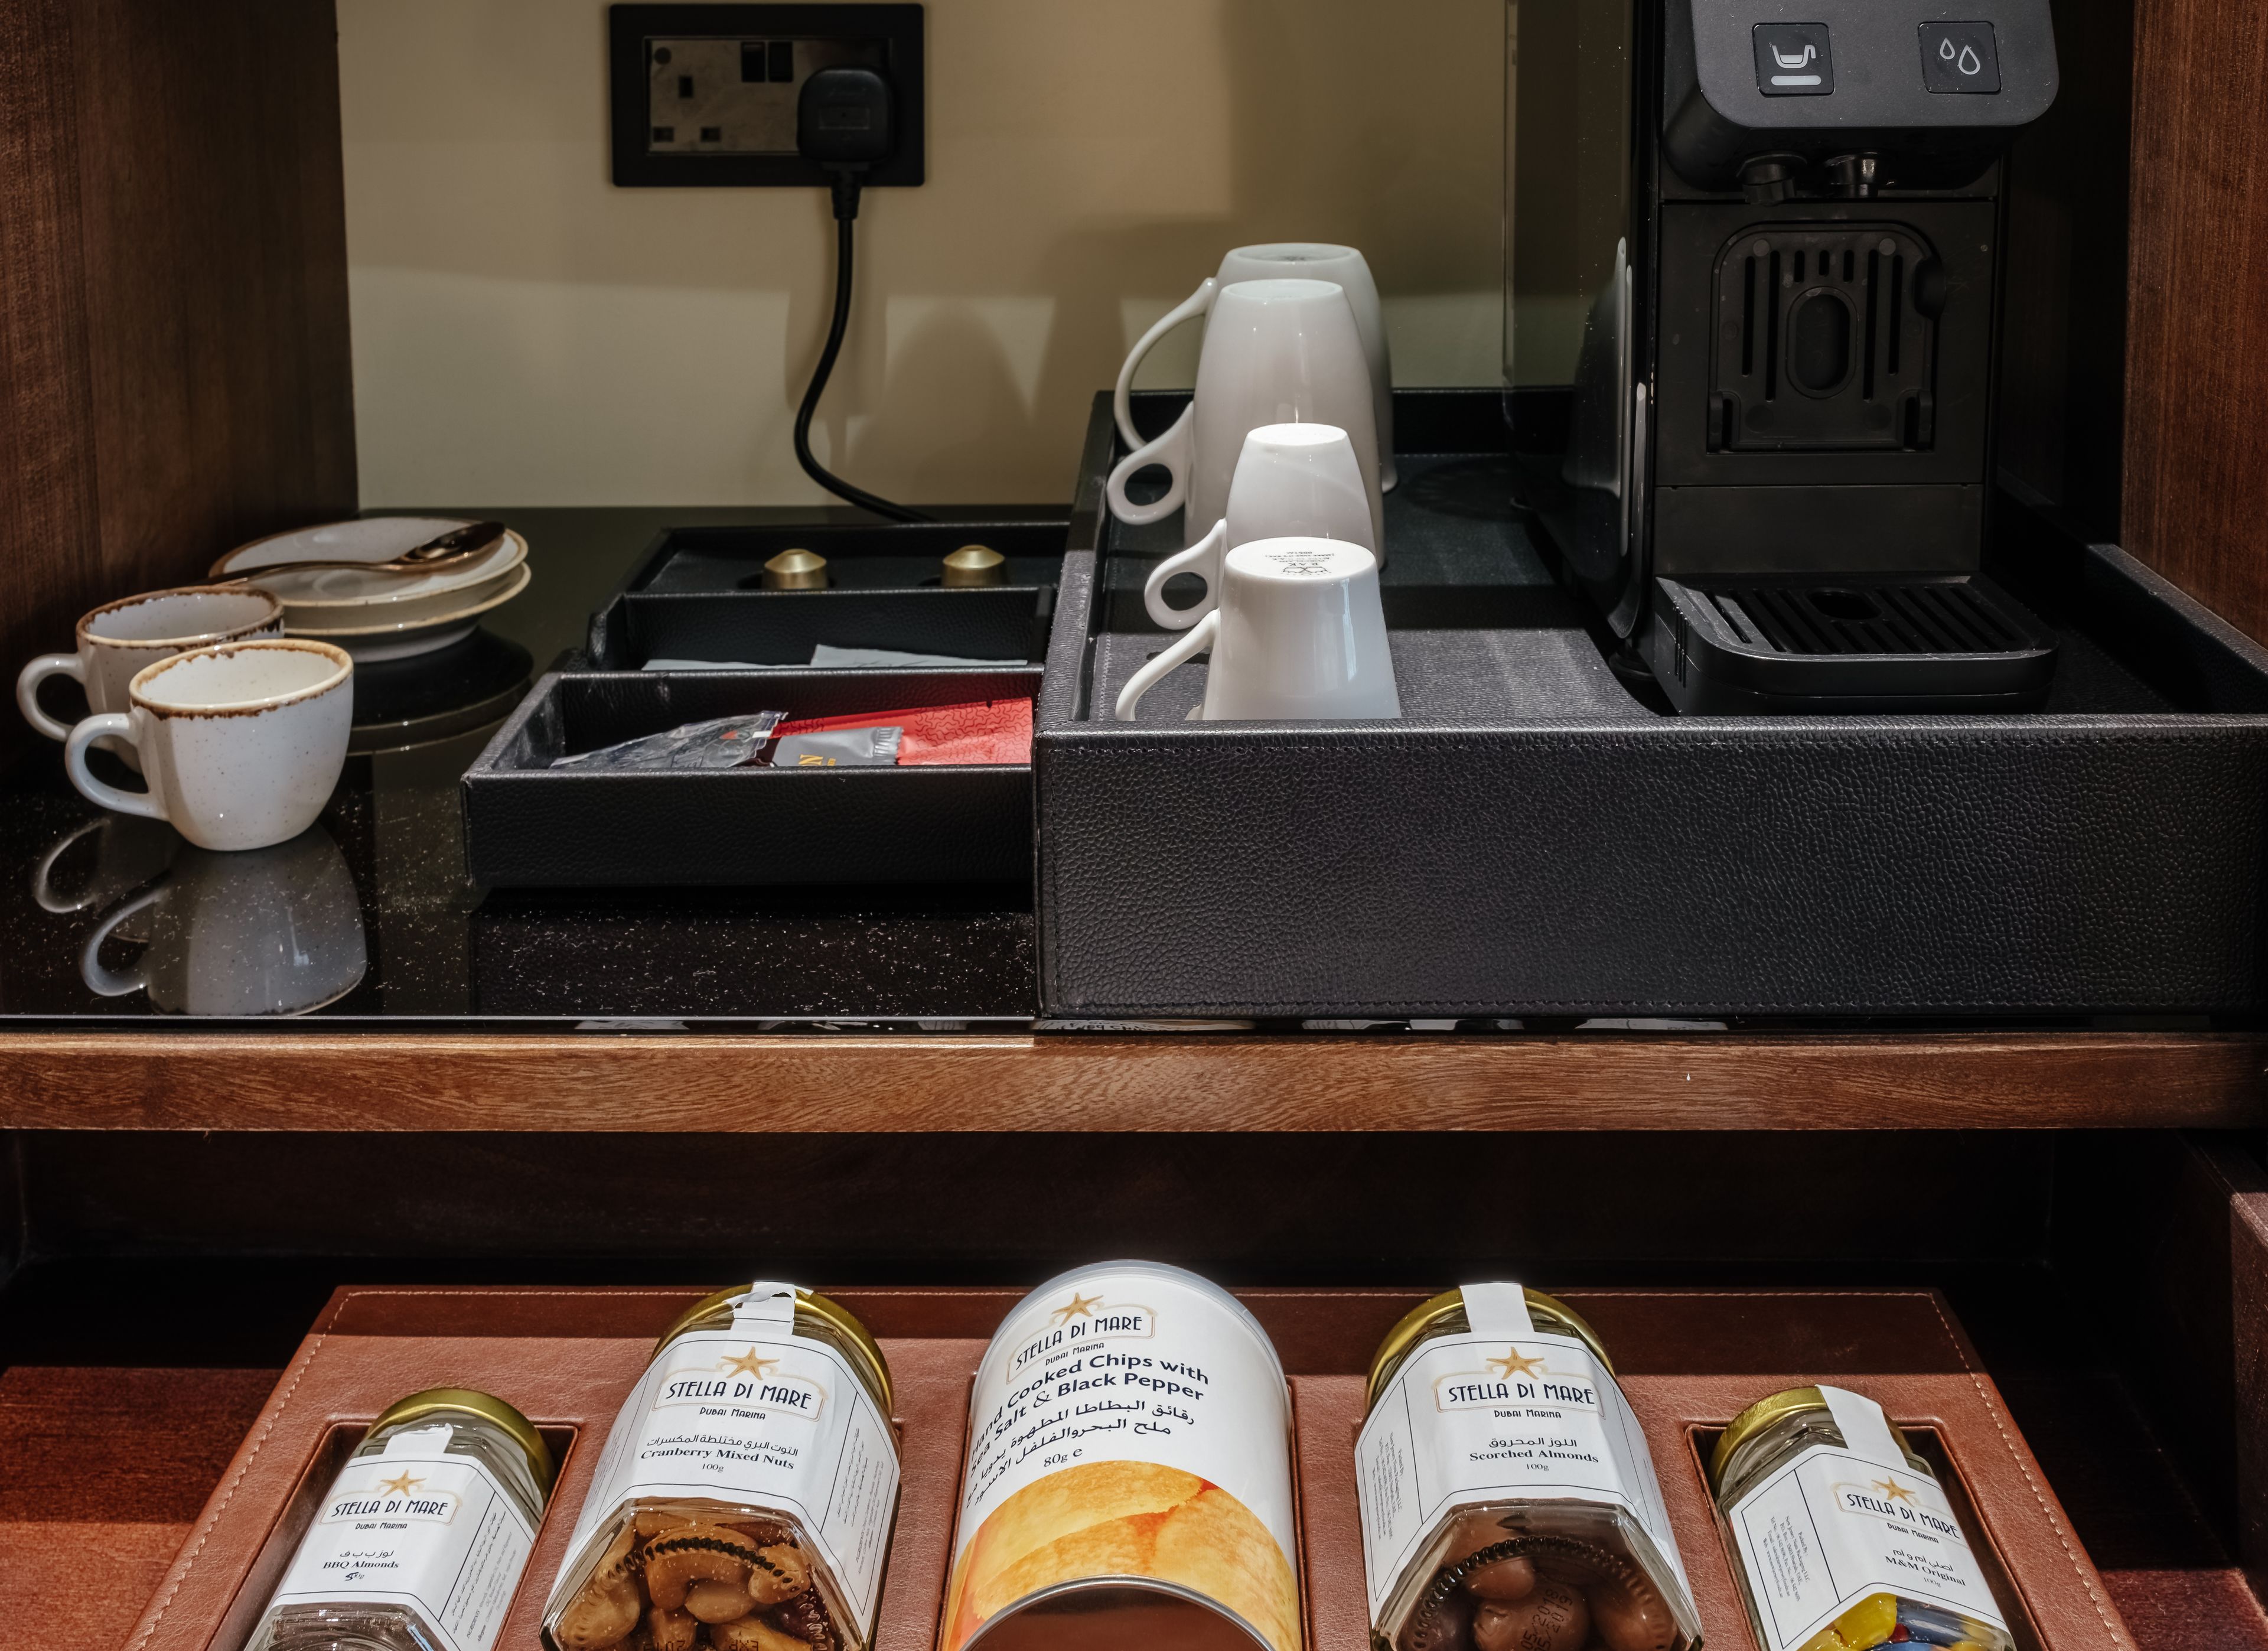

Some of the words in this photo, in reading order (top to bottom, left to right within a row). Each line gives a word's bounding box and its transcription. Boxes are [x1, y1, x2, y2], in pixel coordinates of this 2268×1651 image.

[1016, 1330, 1063, 1370] STELLA
[1071, 1321, 1086, 1339] DI
[1095, 1315, 1142, 1333] MARE
[1045, 1352, 1068, 1366] DUBAI
[1073, 1342, 1104, 1355] MARINA
[666, 1380, 725, 1401] STELLA
[735, 1383, 754, 1399] DI
[760, 1386, 812, 1409] MARE
[1448, 1382, 1508, 1403] STELLA
[1517, 1383, 1536, 1399] DI
[1544, 1384, 1595, 1405] MARE
[699, 1406, 726, 1416] DUBAI
[731, 1408, 766, 1421] MARINA
[972, 1405, 1003, 1462] Hand
[1007, 1360, 1082, 1409] Cooked
[1089, 1353, 1153, 1370] Chips
[1160, 1359, 1208, 1385] with
[1076, 1400, 1145, 1415] البطاطا
[1152, 1403, 1194, 1425] رقائق
[1494, 1409, 1521, 1418] DUBAI
[1526, 1409, 1562, 1418] MARINA
[971, 1442, 990, 1479] Sea
[994, 1406, 1027, 1441] Salt
[1034, 1391, 1053, 1408] &
[1057, 1373, 1116, 1398] Black
[1124, 1373, 1205, 1401] Pepper
[1134, 1421, 1171, 1435] ملح
[647, 1434, 699, 1446] المكسرات
[700, 1435, 742, 1446] مختلطة
[744, 1441, 770, 1451] البري
[1488, 1437, 1545, 1448] المحروق
[1547, 1437, 1578, 1447] اللوز
[771, 1444, 799, 1457] التوت
[1469, 1450, 1533, 1461] Scorched
[1538, 1450, 1599, 1463] Almonds
[641, 1448, 712, 1459] Cranberry
[716, 1449, 759, 1462] Mixed
[762, 1454, 794, 1470] Nuts
[1044, 1453, 1068, 1467] 80g
[702, 1463, 724, 1473] 100g
[1526, 1463, 1549, 1471] 100g
[331, 1500, 381, 1517] STELLA
[384, 1500, 402, 1513] DI
[405, 1500, 448, 1516] MARE
[1846, 1494, 1895, 1516] STELLA
[1899, 1506, 1916, 1522] DI
[1919, 1512, 1960, 1539] MARE
[1886, 1522, 1909, 1535] DUBAI
[1911, 1529, 1939, 1543] MARINA
[376, 1550, 394, 1558] لوز
[323, 1561, 350, 1569] BBQ
[351, 1561, 399, 1569] Almonds
[1885, 1555, 1920, 1571] M&M
[1921, 1565, 1966, 1587] Original
[1923, 1577, 1941, 1587] 100g
